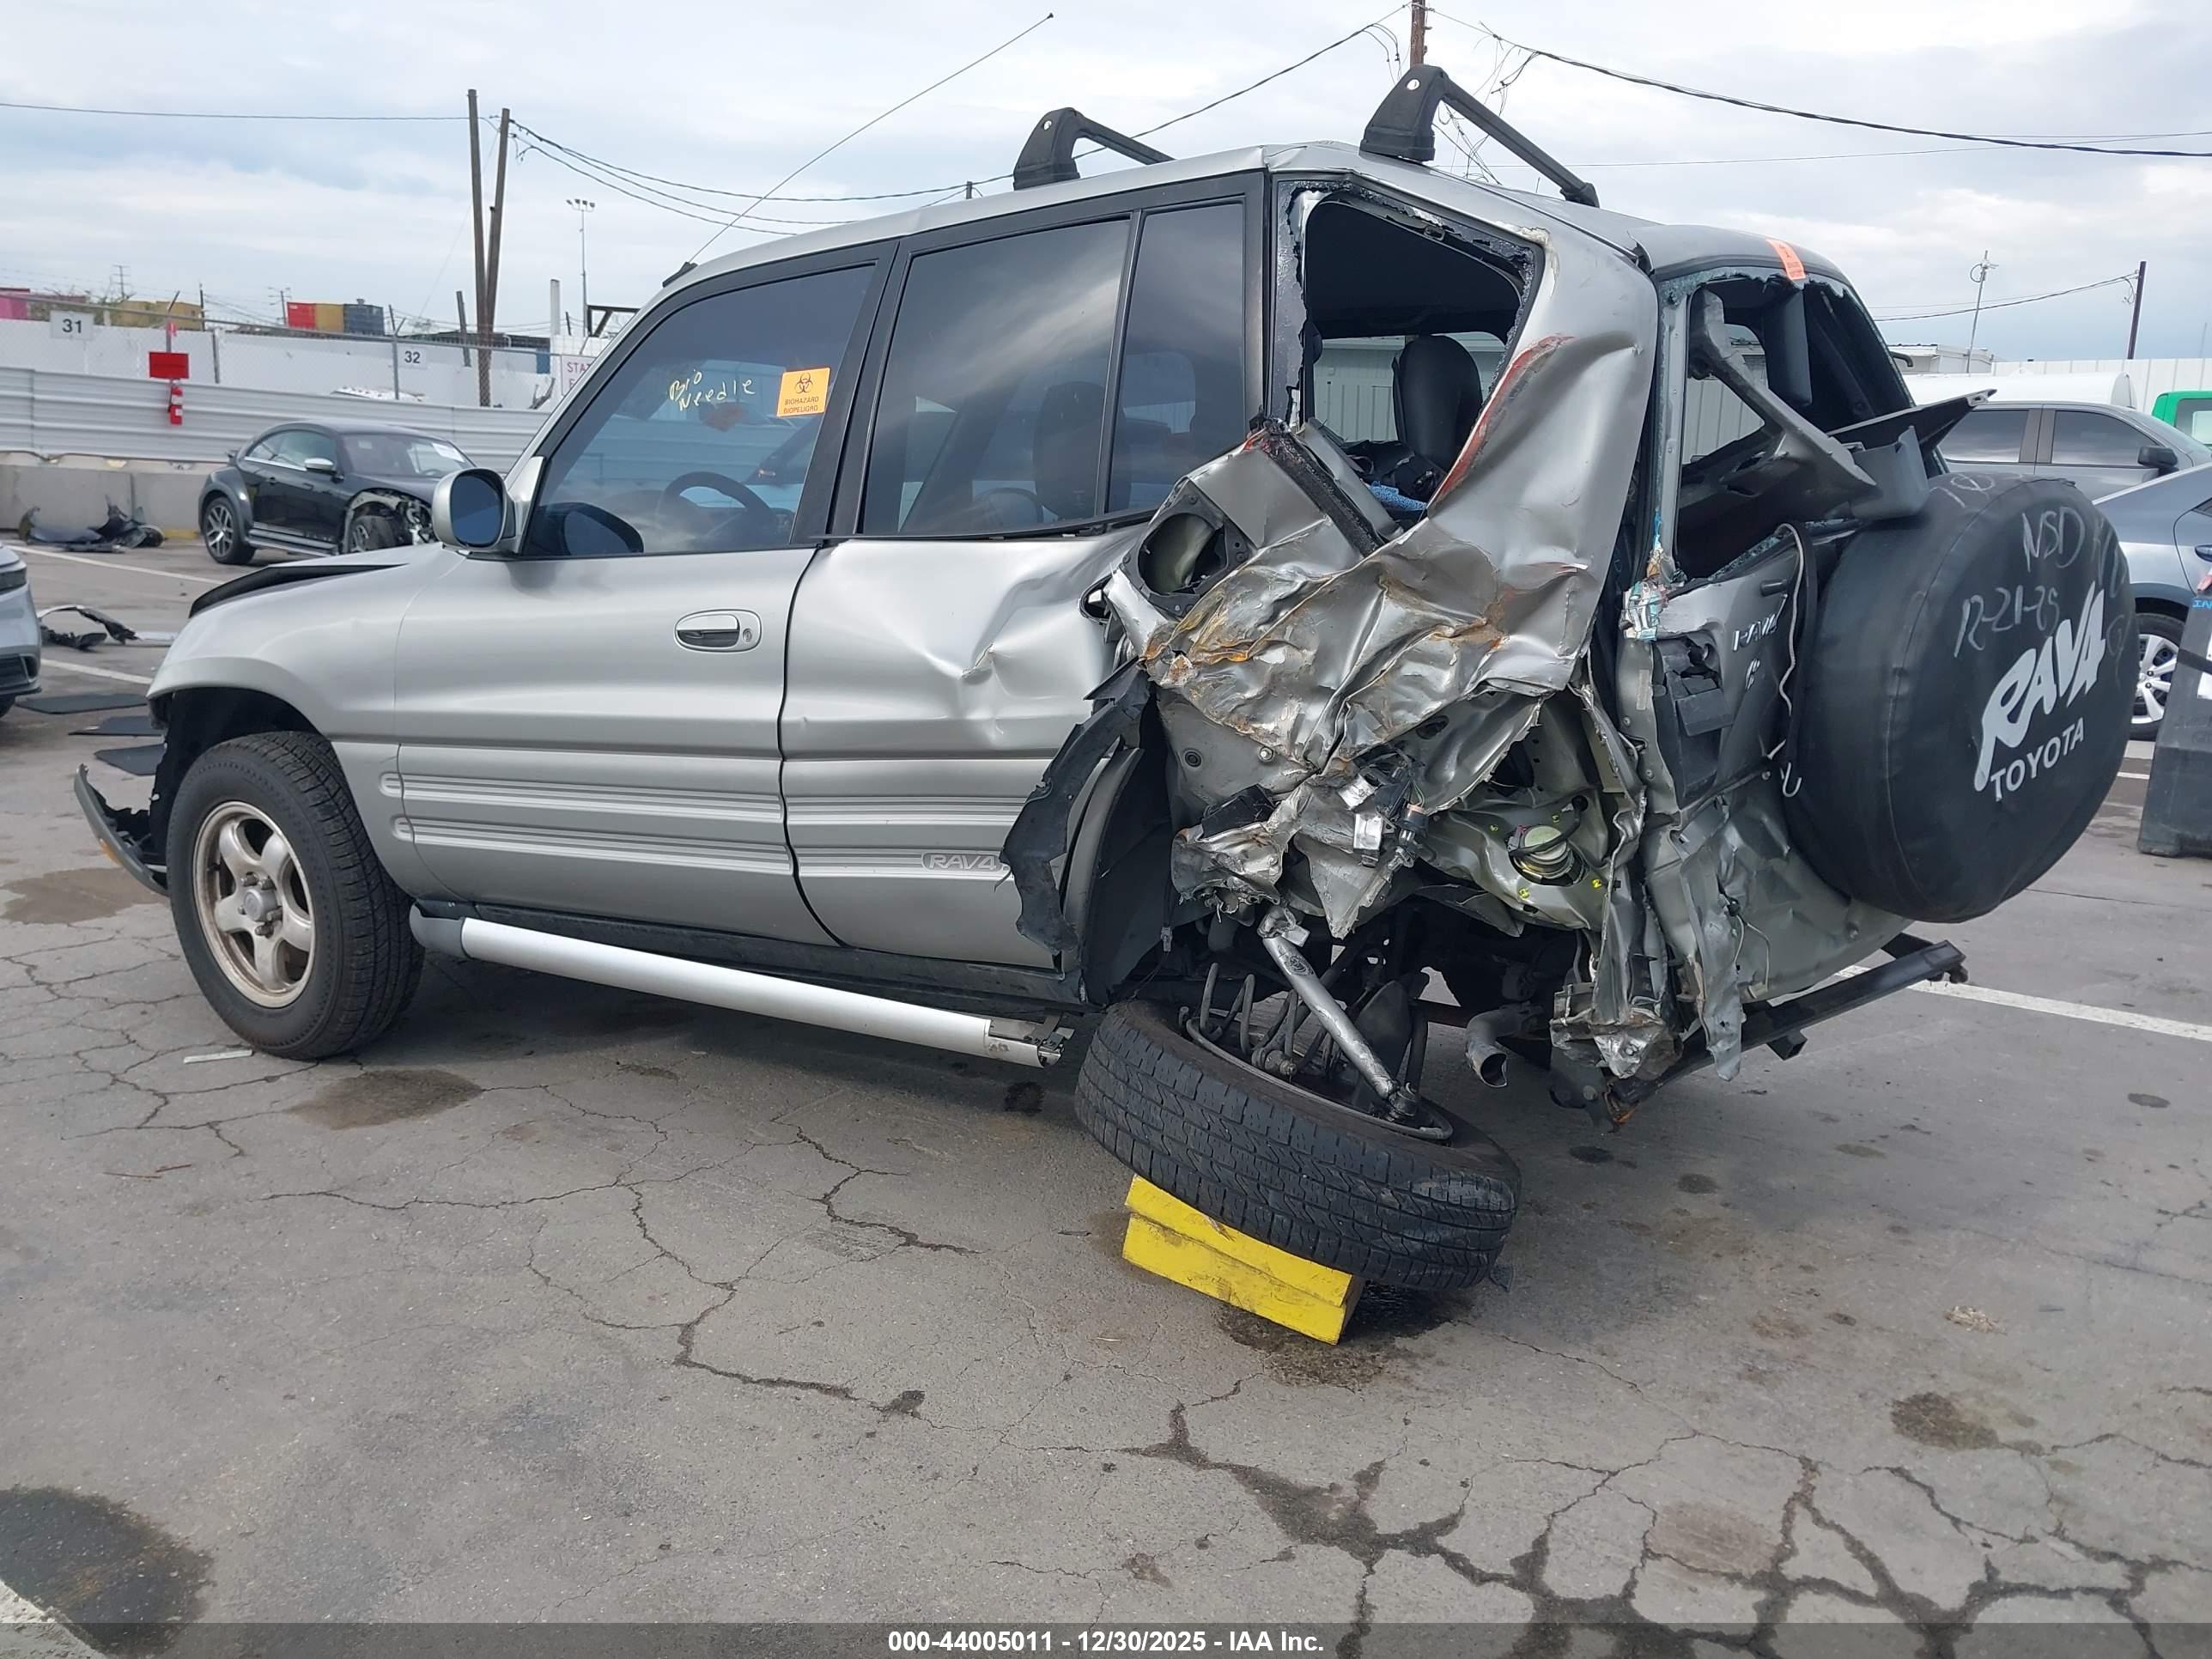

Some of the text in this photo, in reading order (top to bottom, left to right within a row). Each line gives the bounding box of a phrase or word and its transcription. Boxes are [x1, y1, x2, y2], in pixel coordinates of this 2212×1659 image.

[62, 319, 82, 333] 31
[404, 350, 421, 364] 32
[567, 362, 591, 374] STA
[784, 396, 819, 406] BIOHAZARD
[783, 404, 818, 414] BIOPELIGRO
[1974, 580, 2106, 792] RAV4
[1990, 717, 2084, 802] TOYOTA
[928, 854, 997, 870] RAV4
